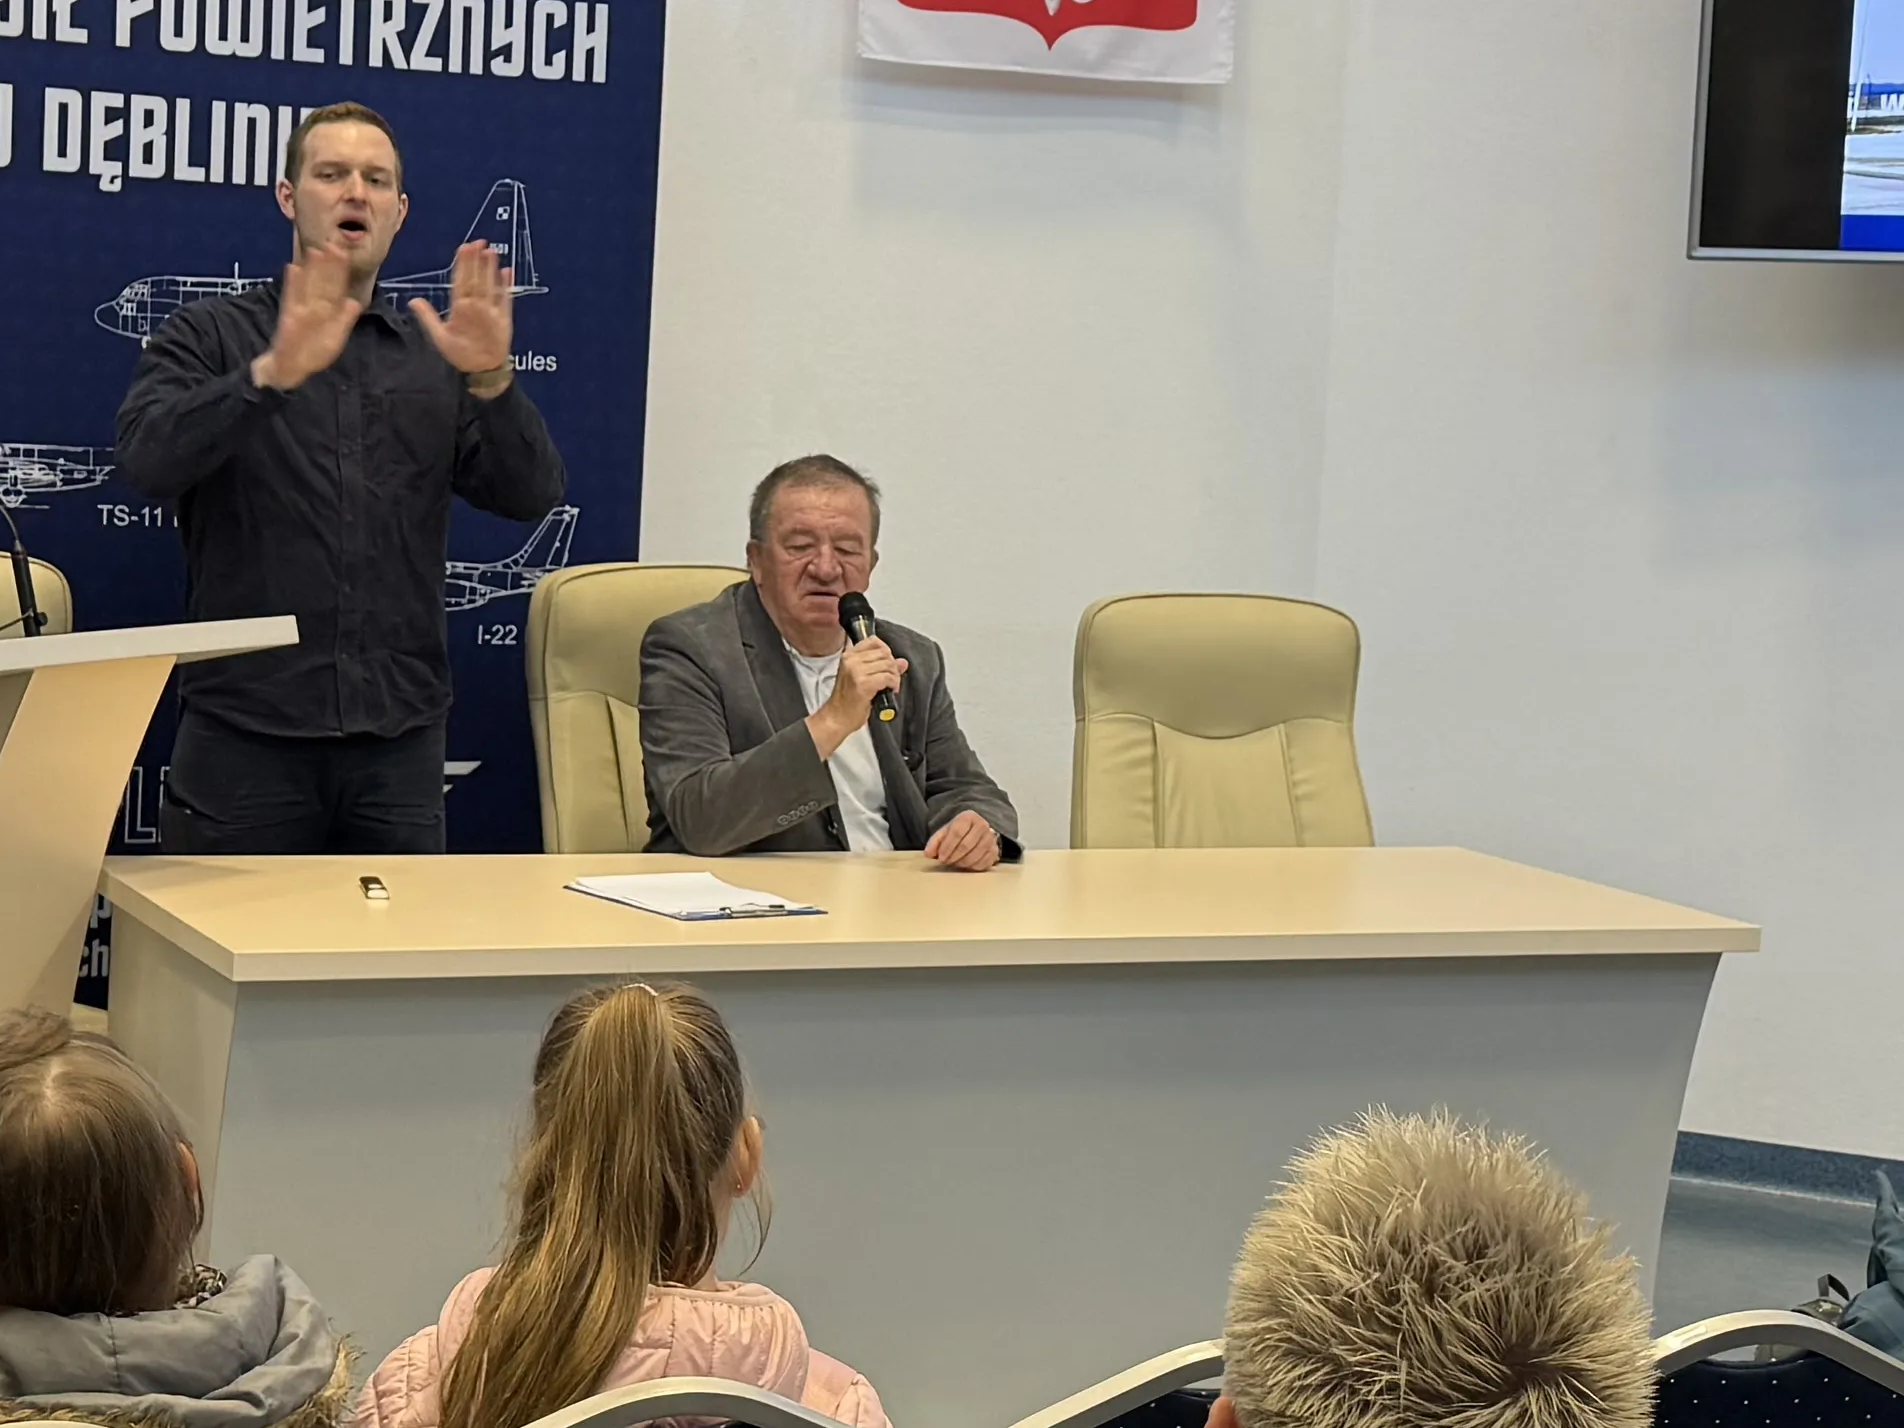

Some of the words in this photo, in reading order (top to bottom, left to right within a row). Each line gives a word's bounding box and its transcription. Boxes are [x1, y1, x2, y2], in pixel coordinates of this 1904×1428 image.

[42, 86, 320, 193] DĘBLINI
[97, 504, 163, 527] TS-11
[478, 624, 518, 645] I-22
